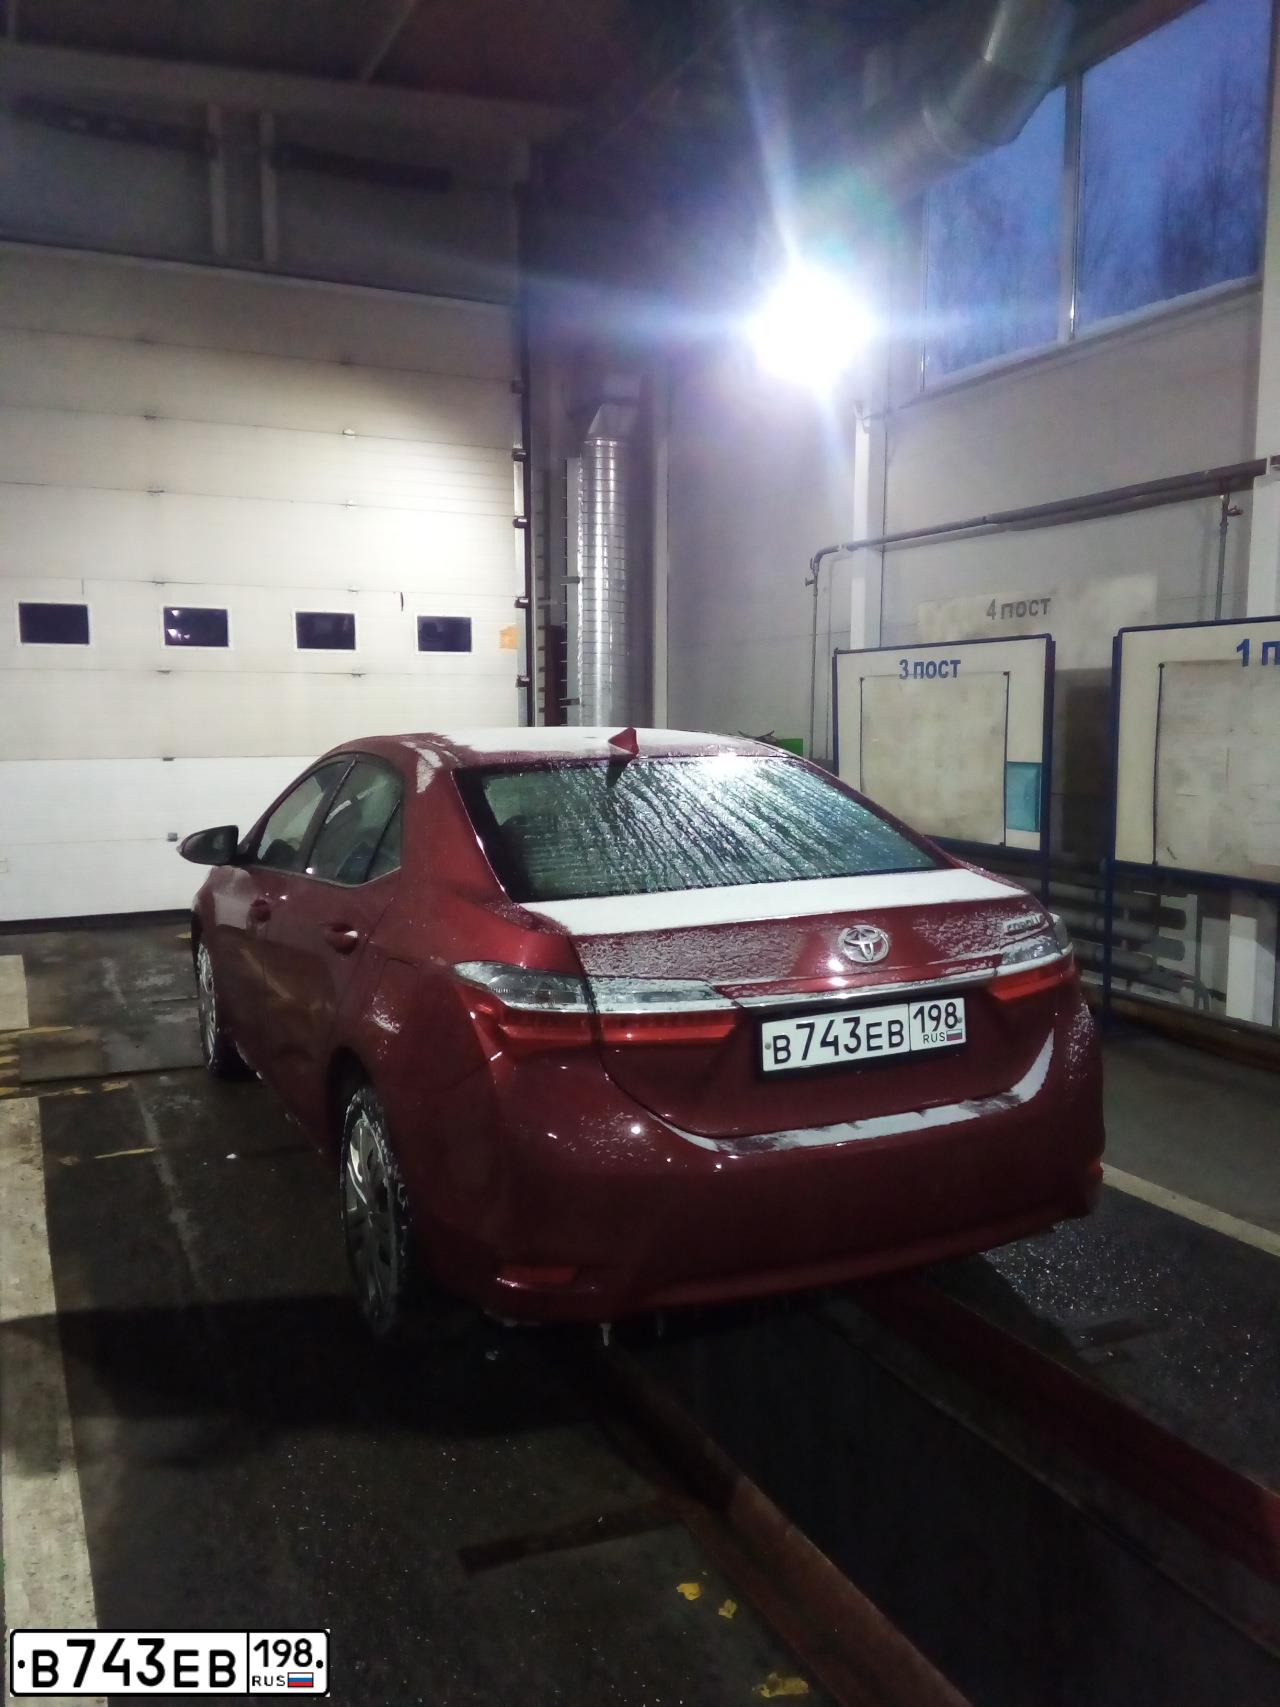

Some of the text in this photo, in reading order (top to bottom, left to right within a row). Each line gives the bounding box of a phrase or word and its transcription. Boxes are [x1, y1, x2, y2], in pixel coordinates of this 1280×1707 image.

[986, 598, 997, 620] 4
[1236, 638, 1250, 667] 1
[899, 658, 909, 680] 3
[913, 1001, 958, 1033] 198
[922, 1031, 946, 1044] RUS
